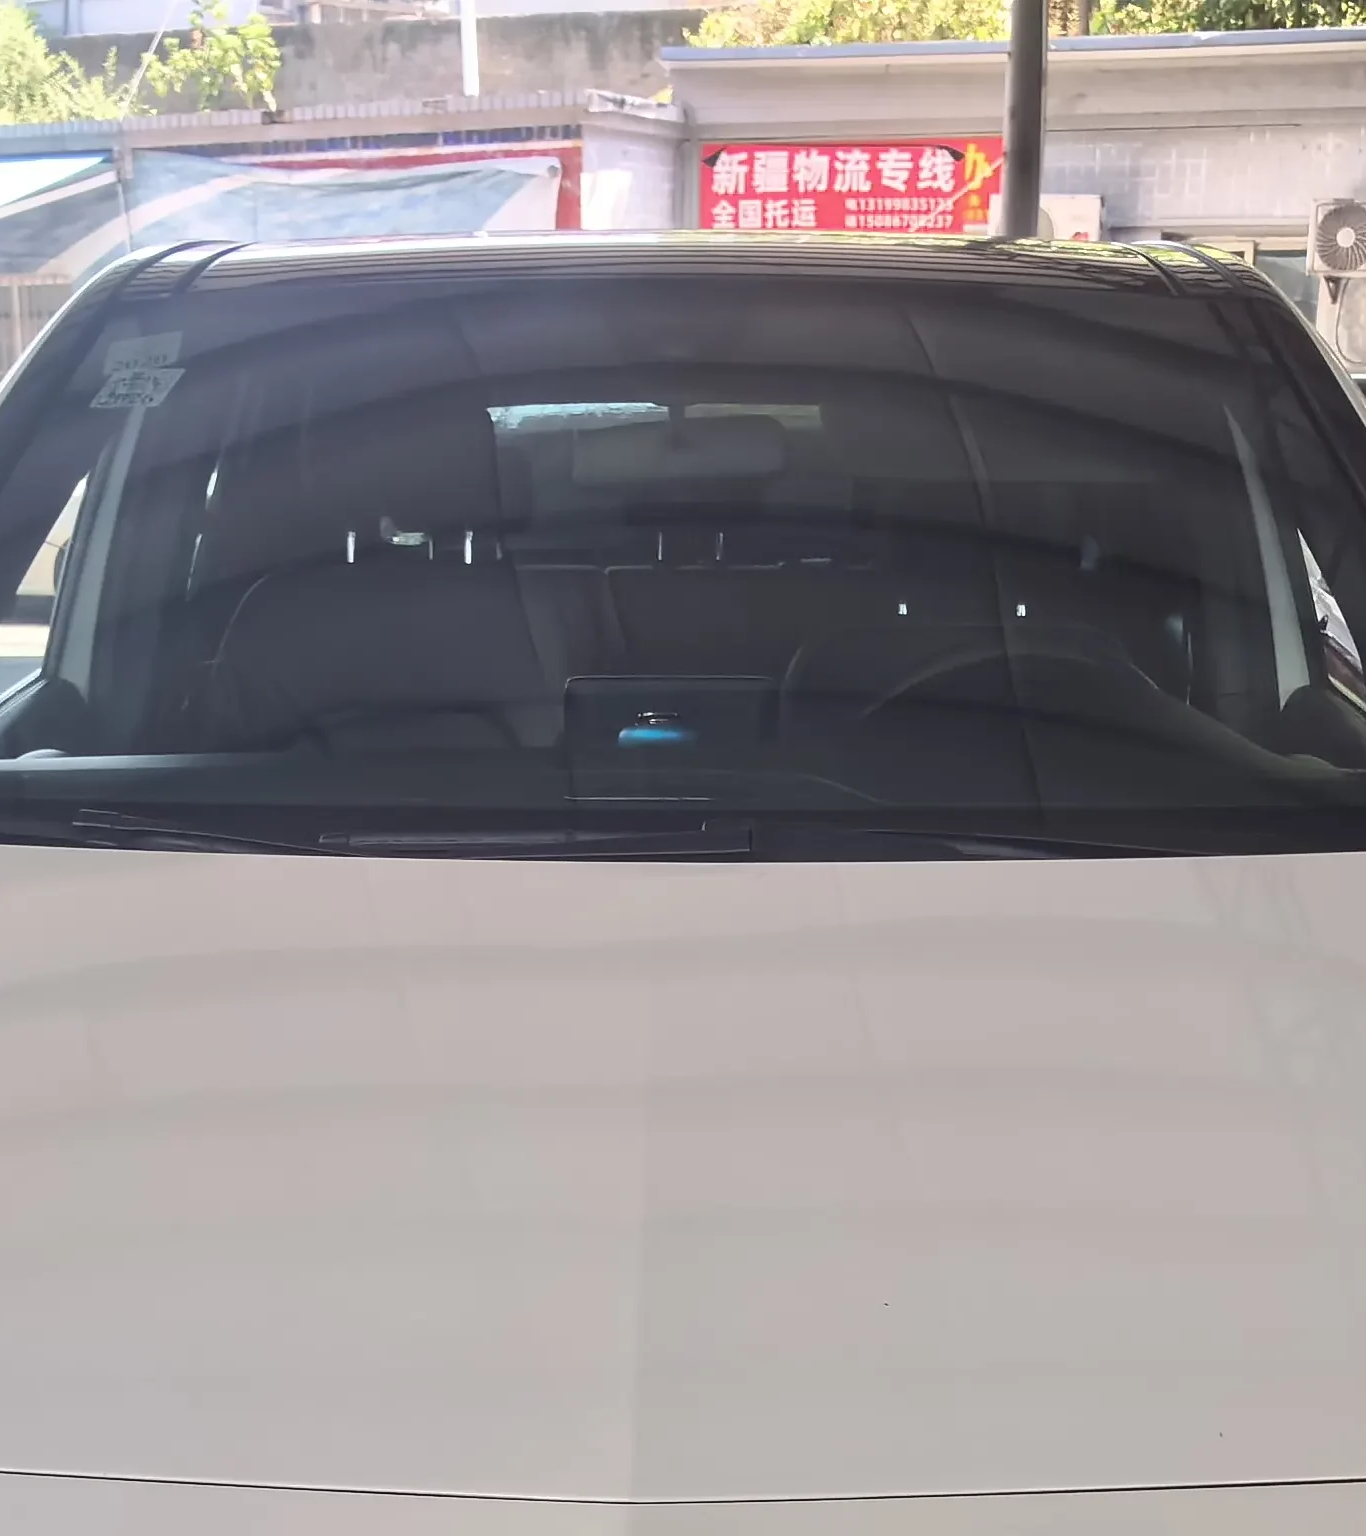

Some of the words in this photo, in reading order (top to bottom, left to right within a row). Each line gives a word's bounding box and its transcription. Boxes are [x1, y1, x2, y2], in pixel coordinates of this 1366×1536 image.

[711, 148, 955, 195] 新疆物流专线
[711, 198, 818, 229] 全国托运
